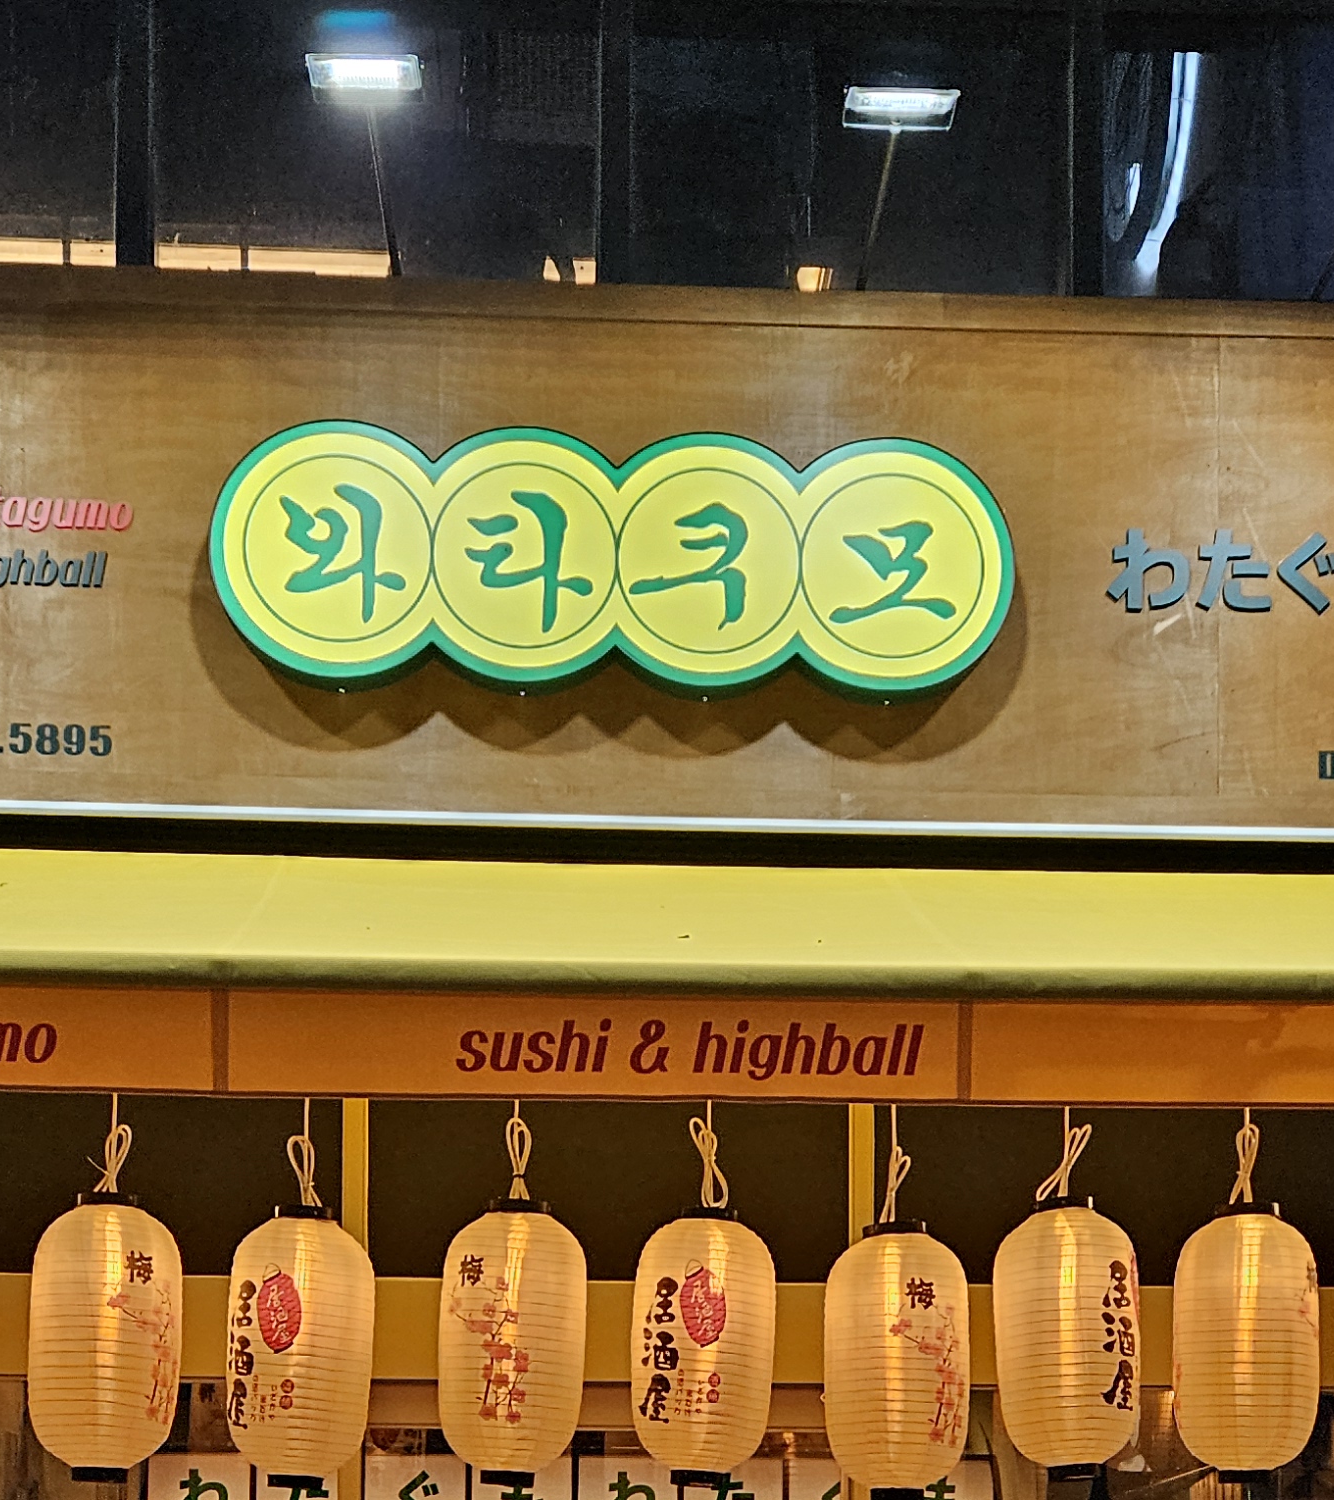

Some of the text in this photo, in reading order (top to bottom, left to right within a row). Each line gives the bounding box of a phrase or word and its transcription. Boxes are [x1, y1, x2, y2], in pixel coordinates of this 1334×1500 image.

[455, 1017, 925, 1082] sushi & highball
